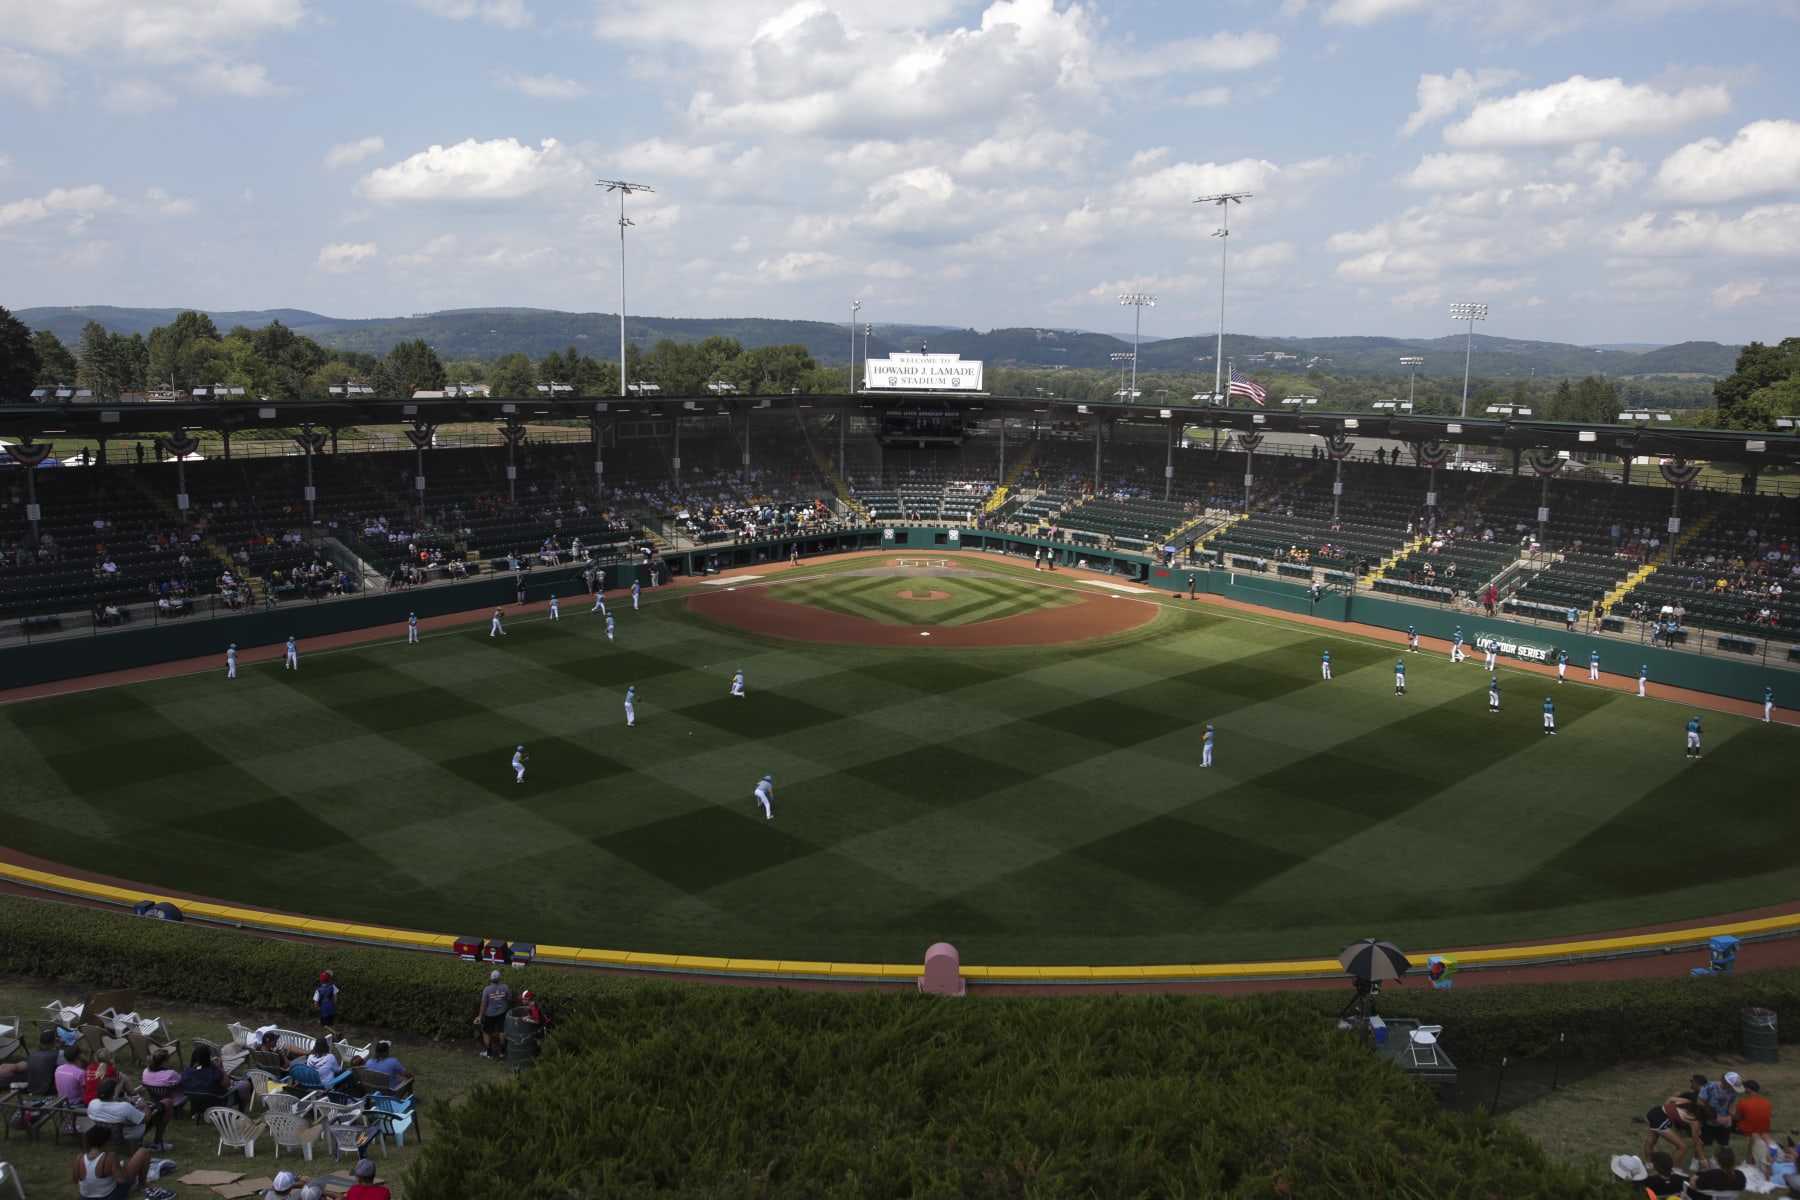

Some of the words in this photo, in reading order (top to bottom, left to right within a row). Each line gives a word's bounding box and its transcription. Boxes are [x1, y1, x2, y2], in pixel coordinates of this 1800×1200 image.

[874, 366, 918, 375] HOWARD
[921, 367, 928, 376] J.
[930, 367, 975, 376] LAMADE
[901, 377, 946, 385] STADIUM
[1517, 646, 1546, 660] SERIES
